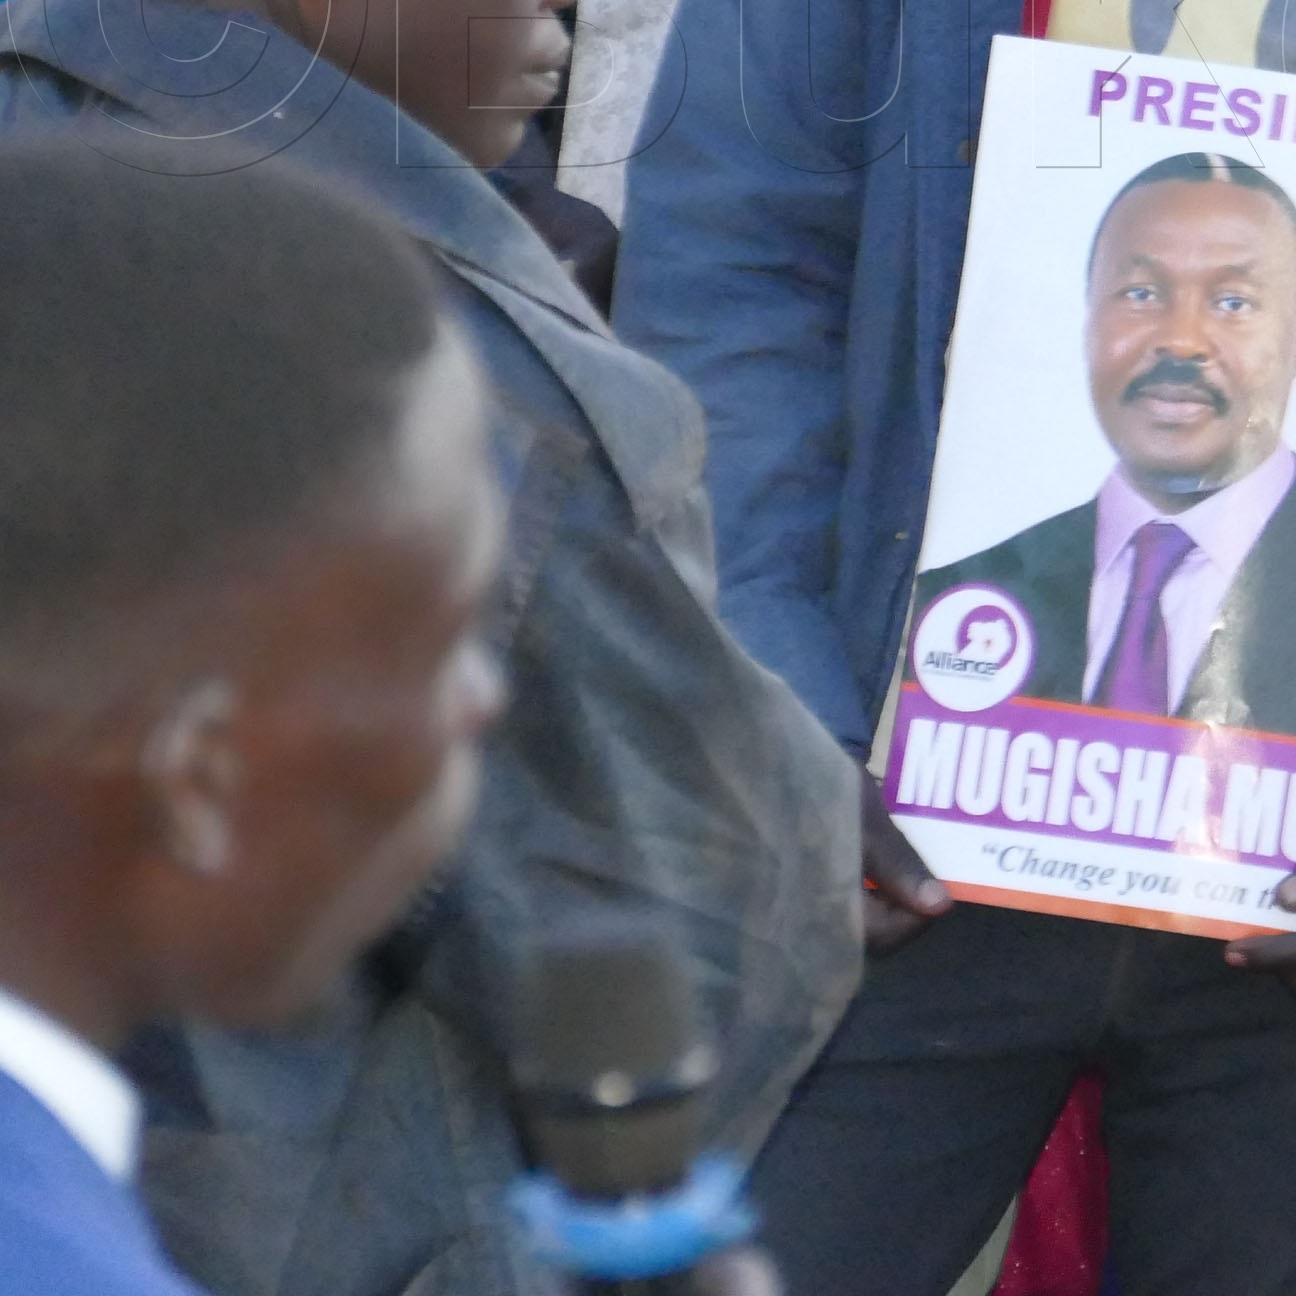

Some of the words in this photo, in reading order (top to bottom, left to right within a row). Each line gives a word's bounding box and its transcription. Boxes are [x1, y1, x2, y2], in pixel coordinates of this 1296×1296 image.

[924, 651, 1000, 675] Alliance
[896, 718, 1217, 848] MUGISHA
[1118, 870, 1181, 896] you
[1193, 881, 1247, 905] can
